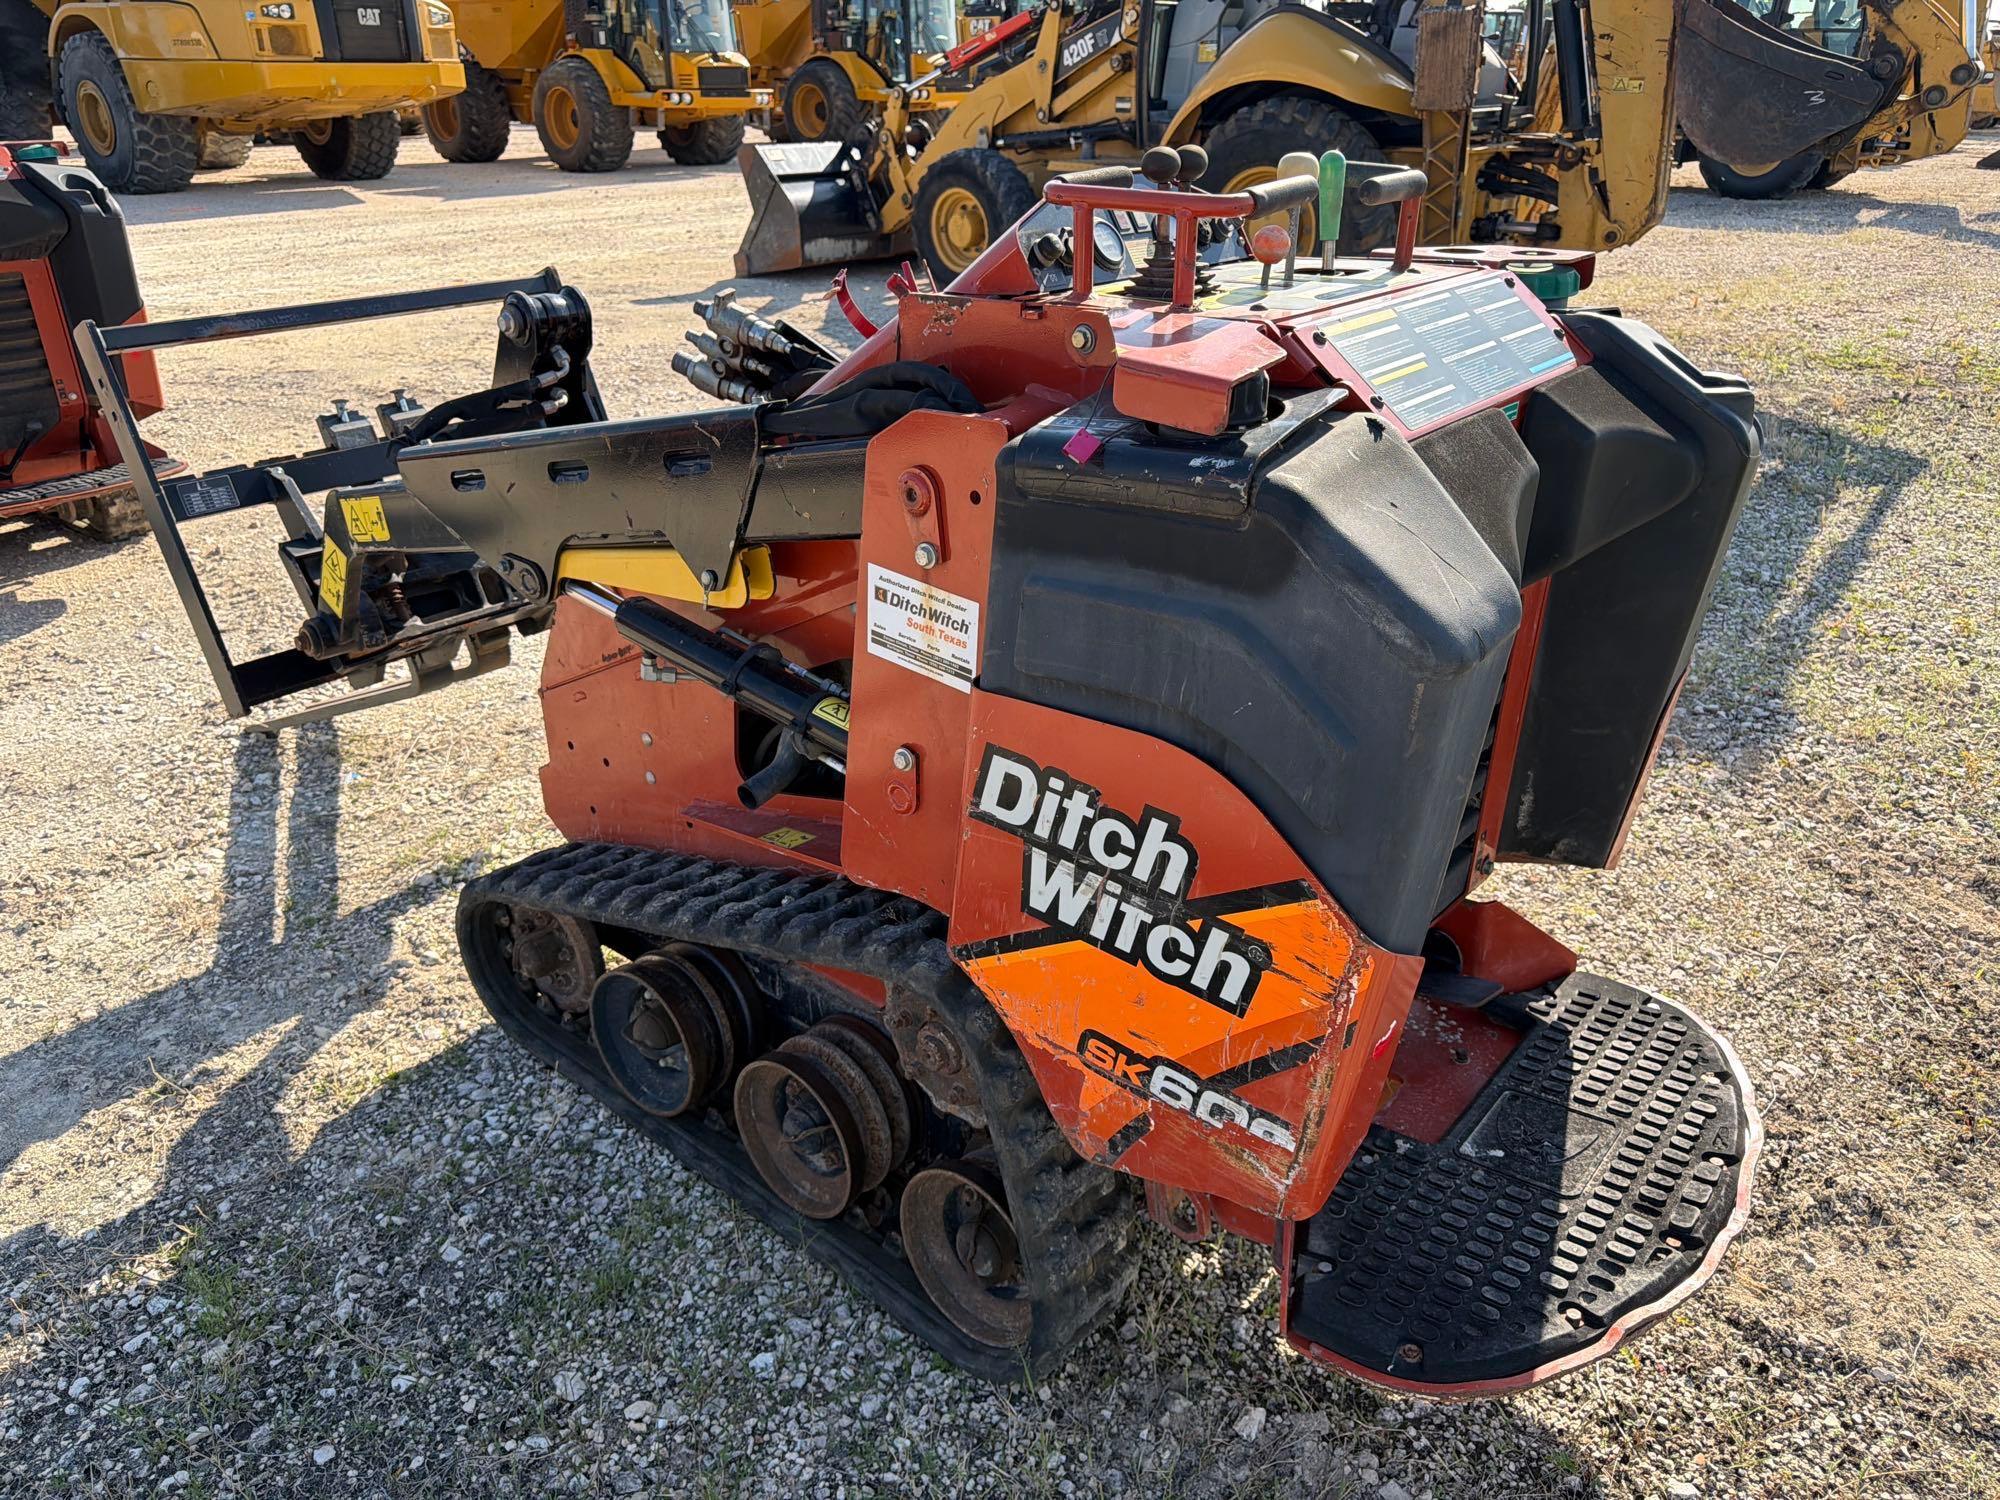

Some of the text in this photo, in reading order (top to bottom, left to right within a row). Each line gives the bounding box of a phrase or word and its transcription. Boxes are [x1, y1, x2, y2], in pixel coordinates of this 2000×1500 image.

[357, 7, 381, 26] CAT
[970, 18, 991, 36] CAT
[1063, 32, 1095, 66] 420F
[879, 575, 910, 591] Authorized
[911, 586, 928, 598] Ditch
[946, 599, 967, 613] Dealer
[873, 622, 970, 666] Sales Service Parts Rentals
[906, 616, 968, 649] South Texas
[978, 754, 1189, 896] Ditch
[1029, 846, 1251, 1006] Witch
